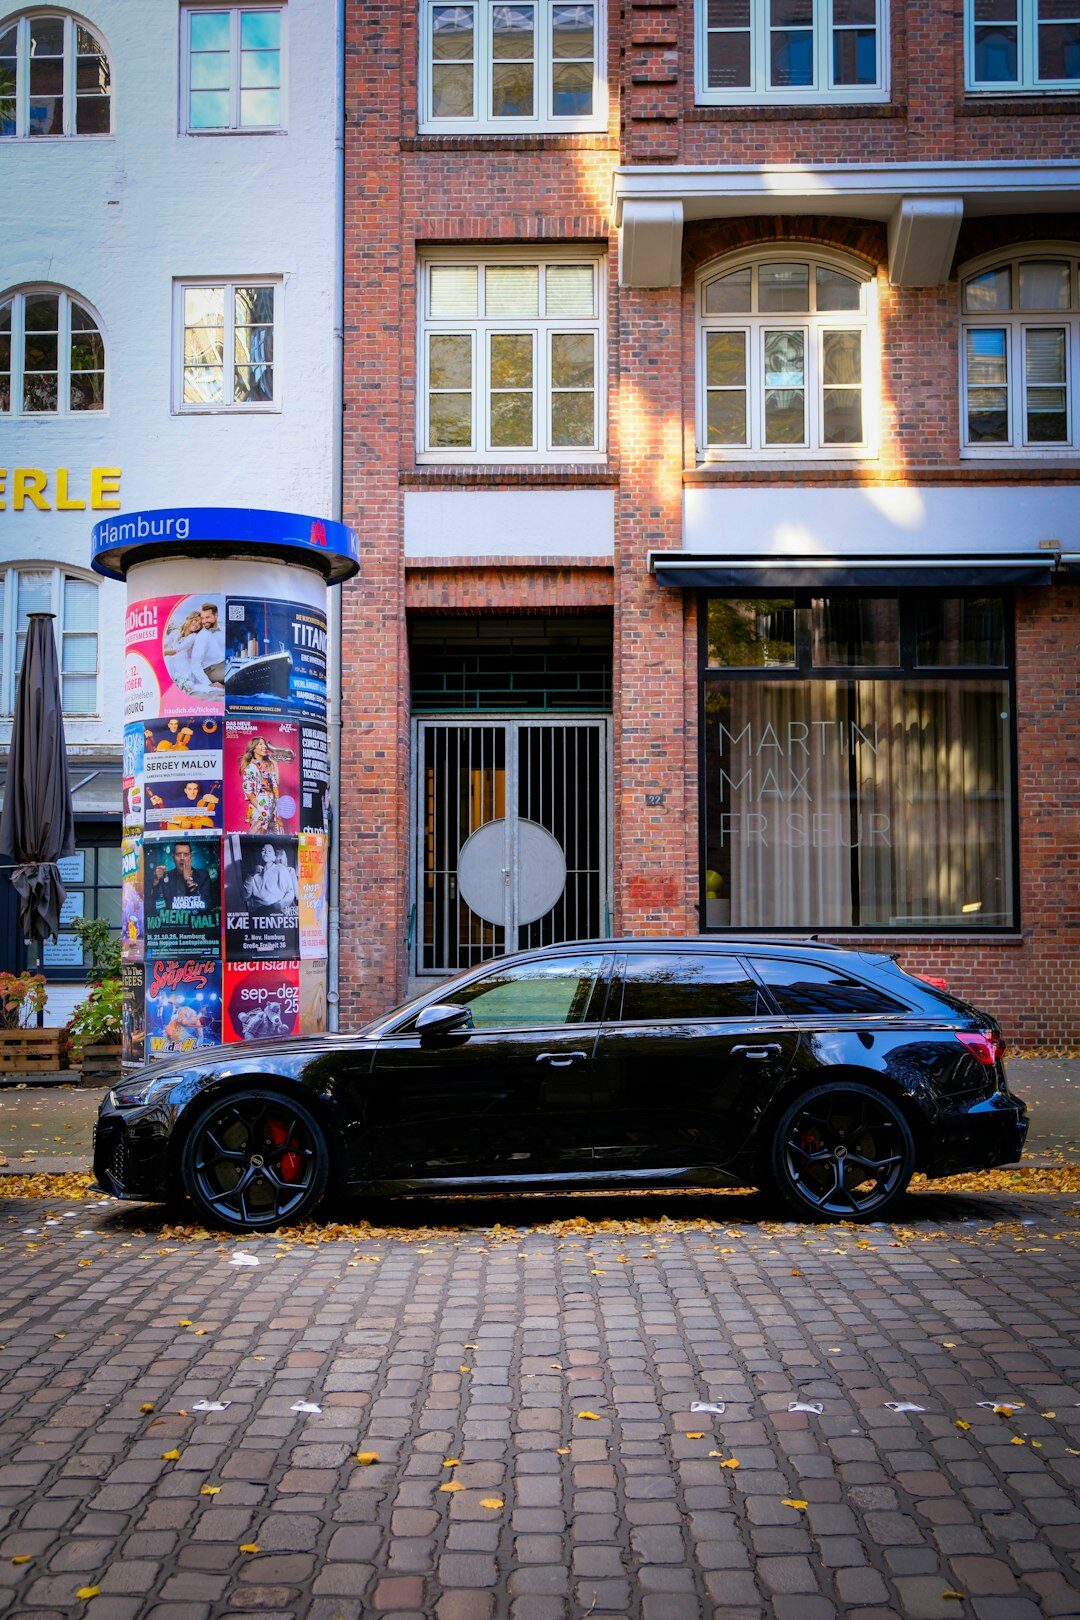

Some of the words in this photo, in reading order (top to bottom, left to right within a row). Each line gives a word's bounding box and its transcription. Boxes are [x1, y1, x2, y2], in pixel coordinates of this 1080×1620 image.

[0, 468, 122, 511] RLE
[100, 516, 190, 546] Hamburg
[125, 678, 142, 691] TOBER
[719, 721, 878, 756] MARTIN
[146, 761, 179, 772] SERGEY
[181, 760, 217, 769] MALOV
[720, 768, 812, 802] MAX
[227, 917, 249, 929] KAE
[252, 916, 299, 929] TEMPEST
[264, 934, 285, 942] Hamburg
[284, 999, 299, 1014] 25
